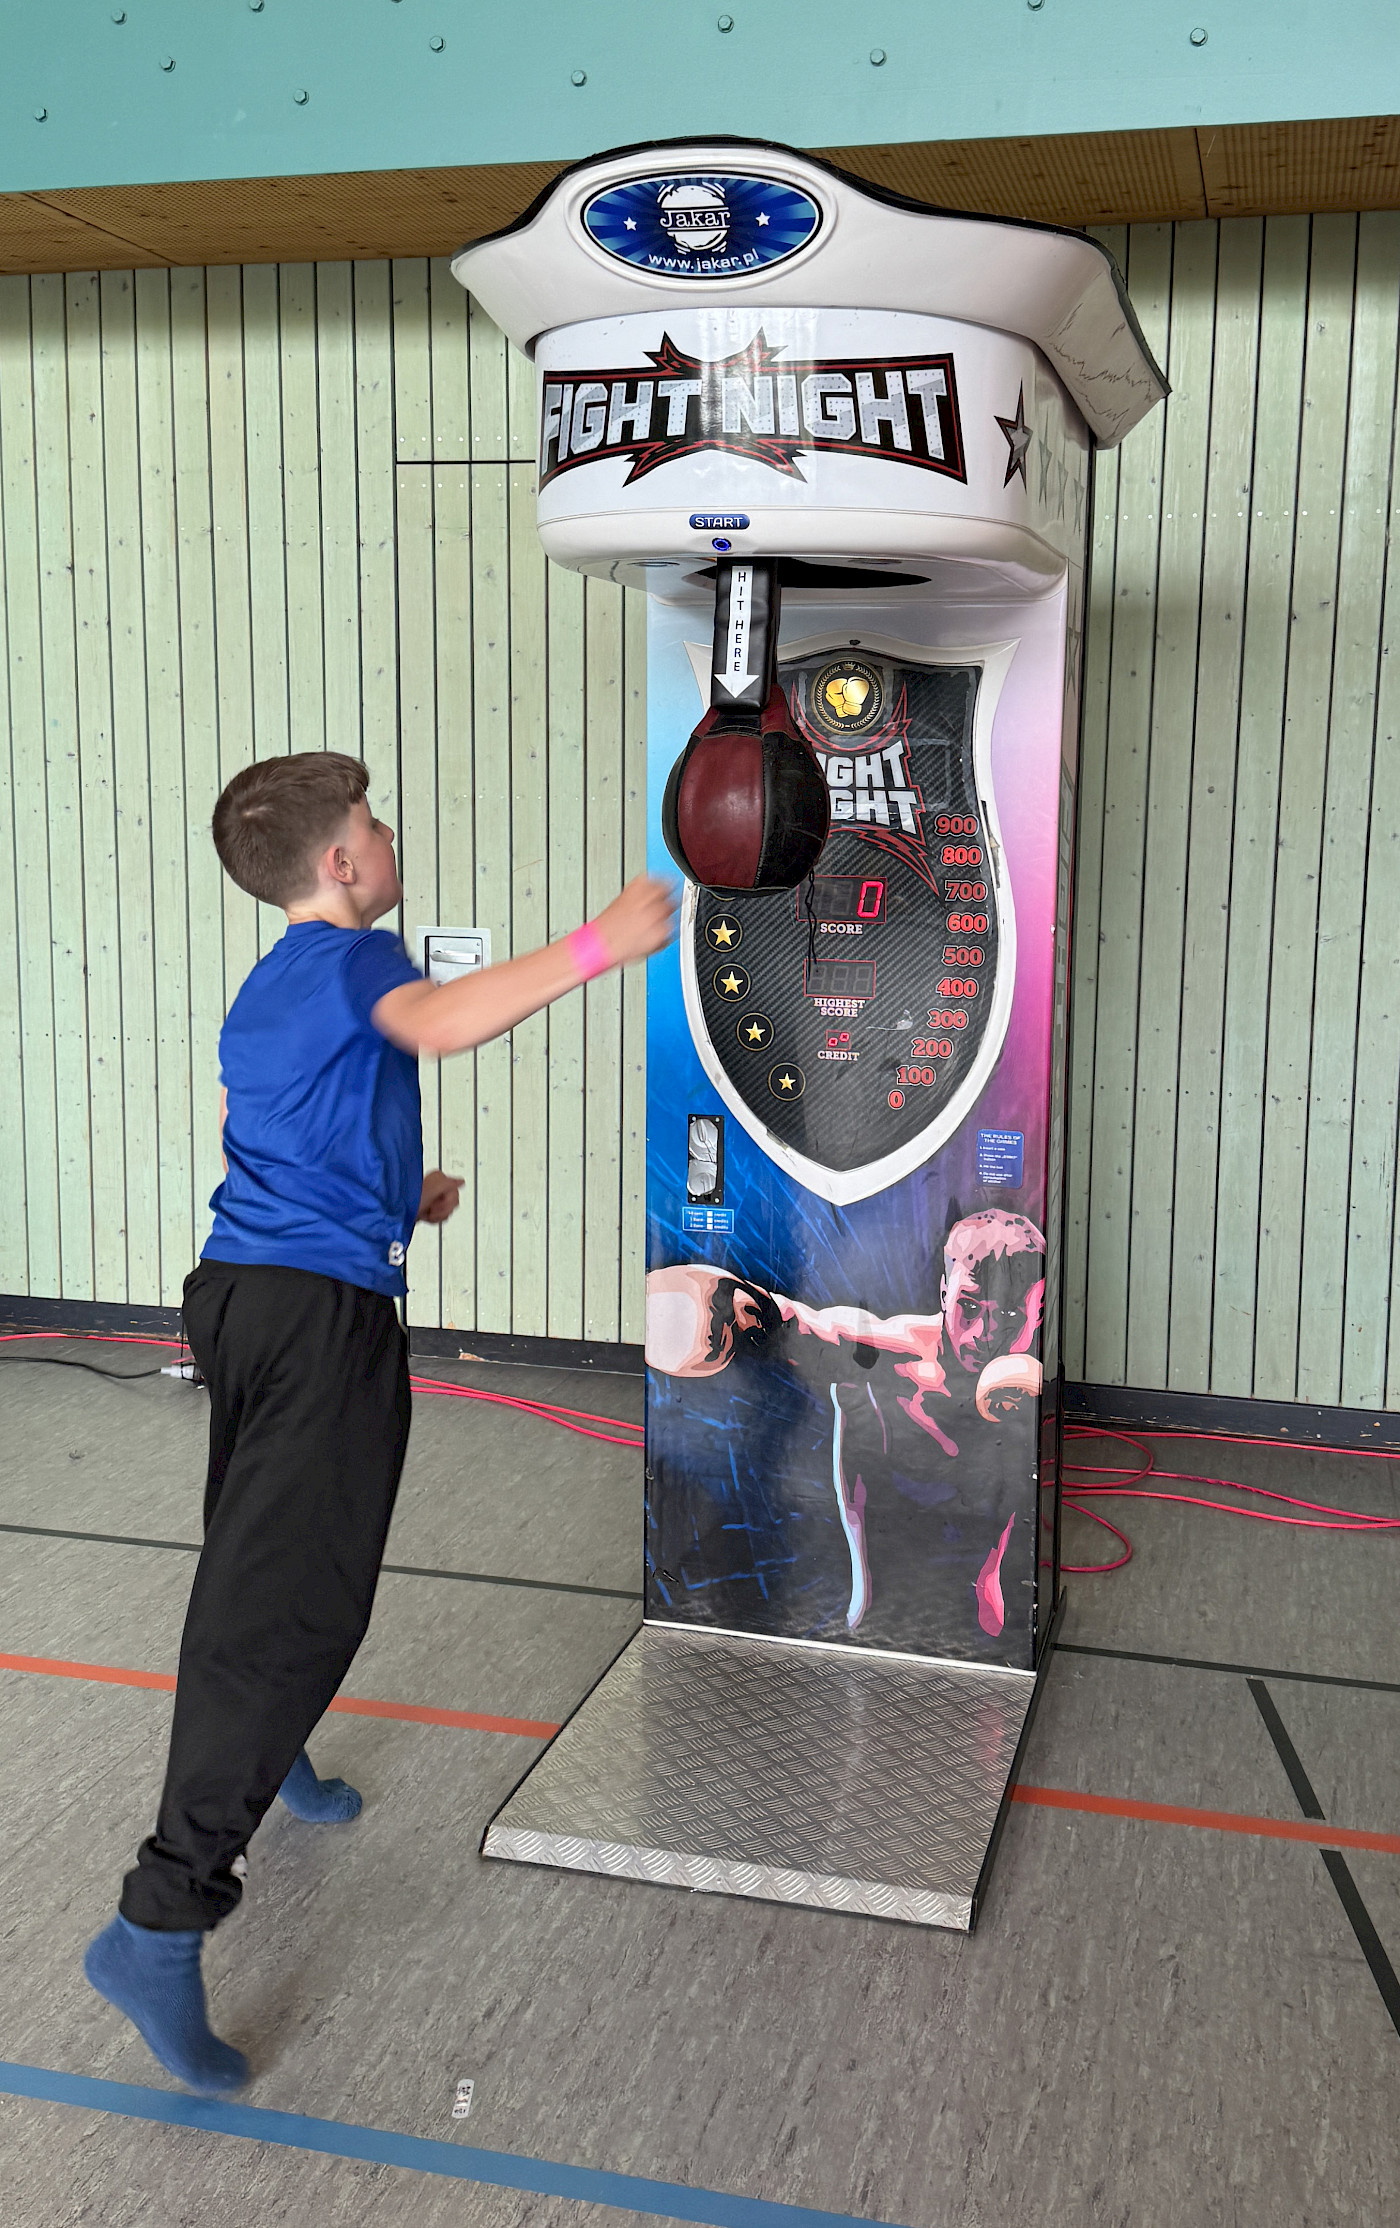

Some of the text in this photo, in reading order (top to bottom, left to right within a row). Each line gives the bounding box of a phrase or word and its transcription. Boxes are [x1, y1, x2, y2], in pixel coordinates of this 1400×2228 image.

[660, 209, 731, 228] Jakar
[648, 247, 760, 271] www.jakar.pl
[541, 368, 948, 477] FIGHT NIGHT
[695, 517, 743, 528] START
[734, 572, 746, 671] HIT HERE
[815, 740, 907, 788] GHT
[828, 789, 917, 835] GHT
[935, 815, 978, 836] 900
[942, 846, 982, 866] 800
[857, 880, 884, 918] 0
[946, 881, 987, 901] 700
[820, 923, 863, 935] SCORE
[947, 913, 988, 933] 600
[942, 946, 984, 966] 500
[937, 978, 978, 997] 400
[813, 997, 866, 1009] HIGHEST
[820, 1007, 858, 1018] SCORE
[928, 1009, 968, 1029] 300
[817, 1050, 860, 1061] CREDIT
[912, 1038, 952, 1058] 200
[897, 1066, 935, 1085] 100
[889, 1091, 904, 1108] 0
